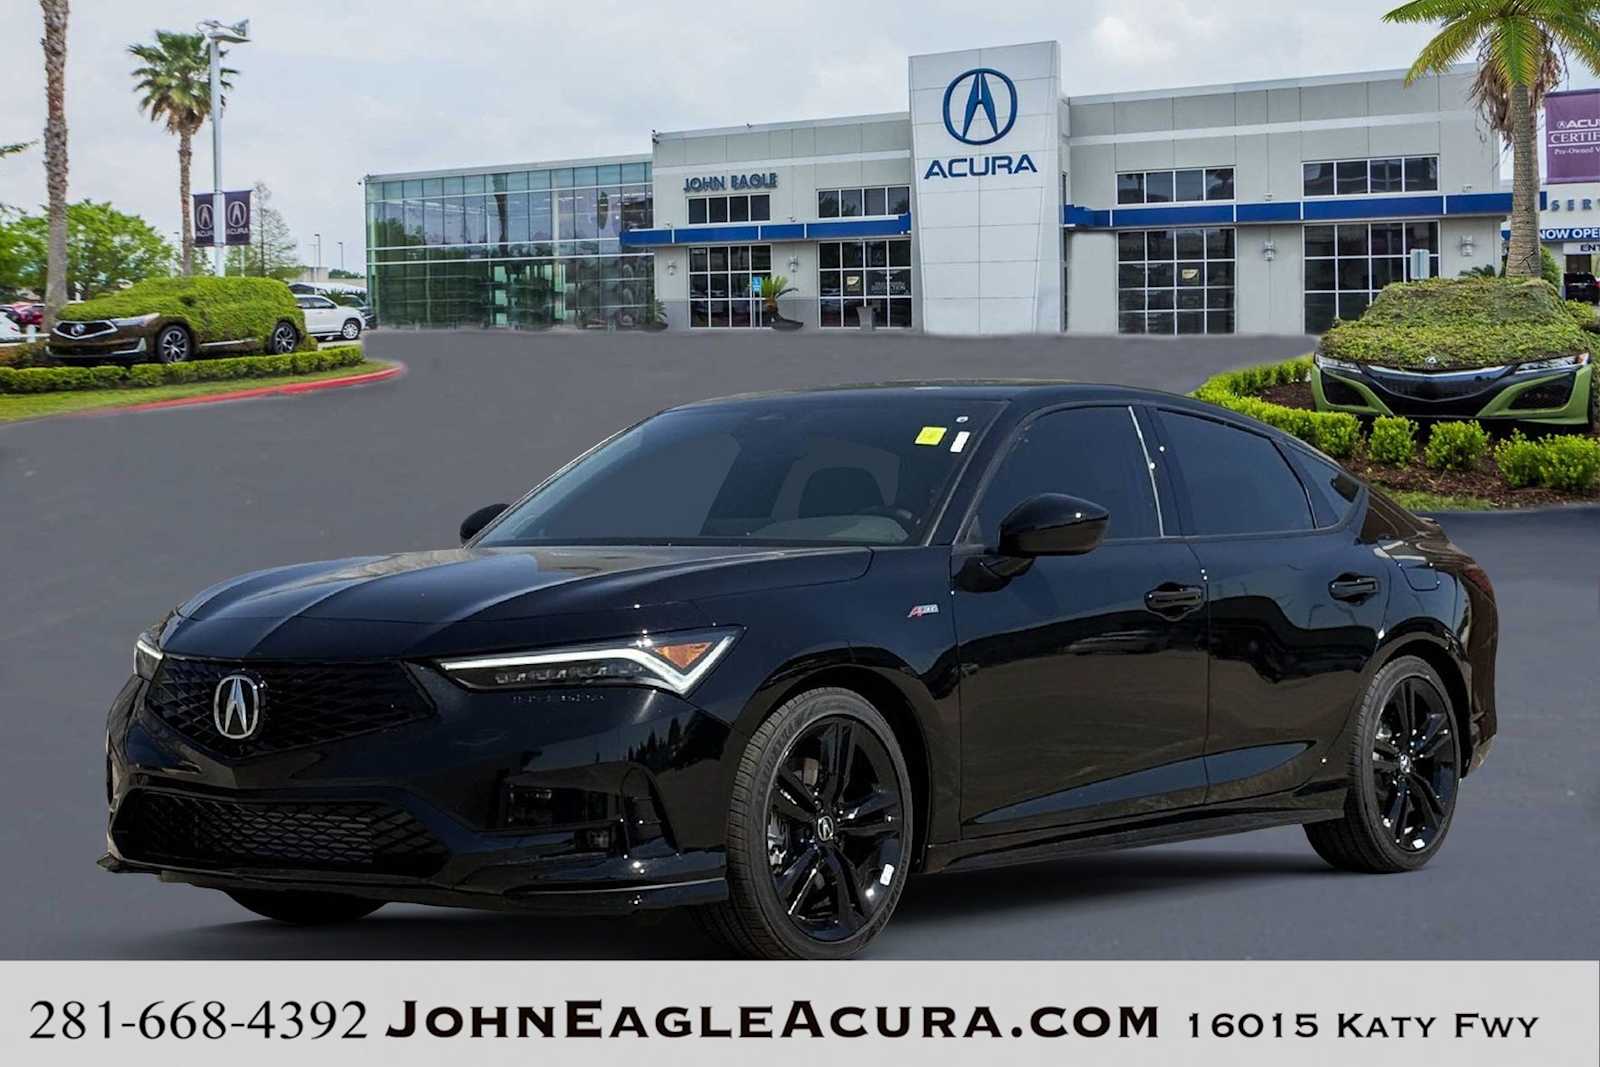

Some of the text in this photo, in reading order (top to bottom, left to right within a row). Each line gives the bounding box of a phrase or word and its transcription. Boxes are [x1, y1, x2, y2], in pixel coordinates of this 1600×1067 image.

[1554, 147, 1594, 155] Pre-Owned
[923, 154, 1038, 179] ACURA
[683, 173, 777, 192] JOHN EAGLE
[1572, 228, 1600, 239] OPE
